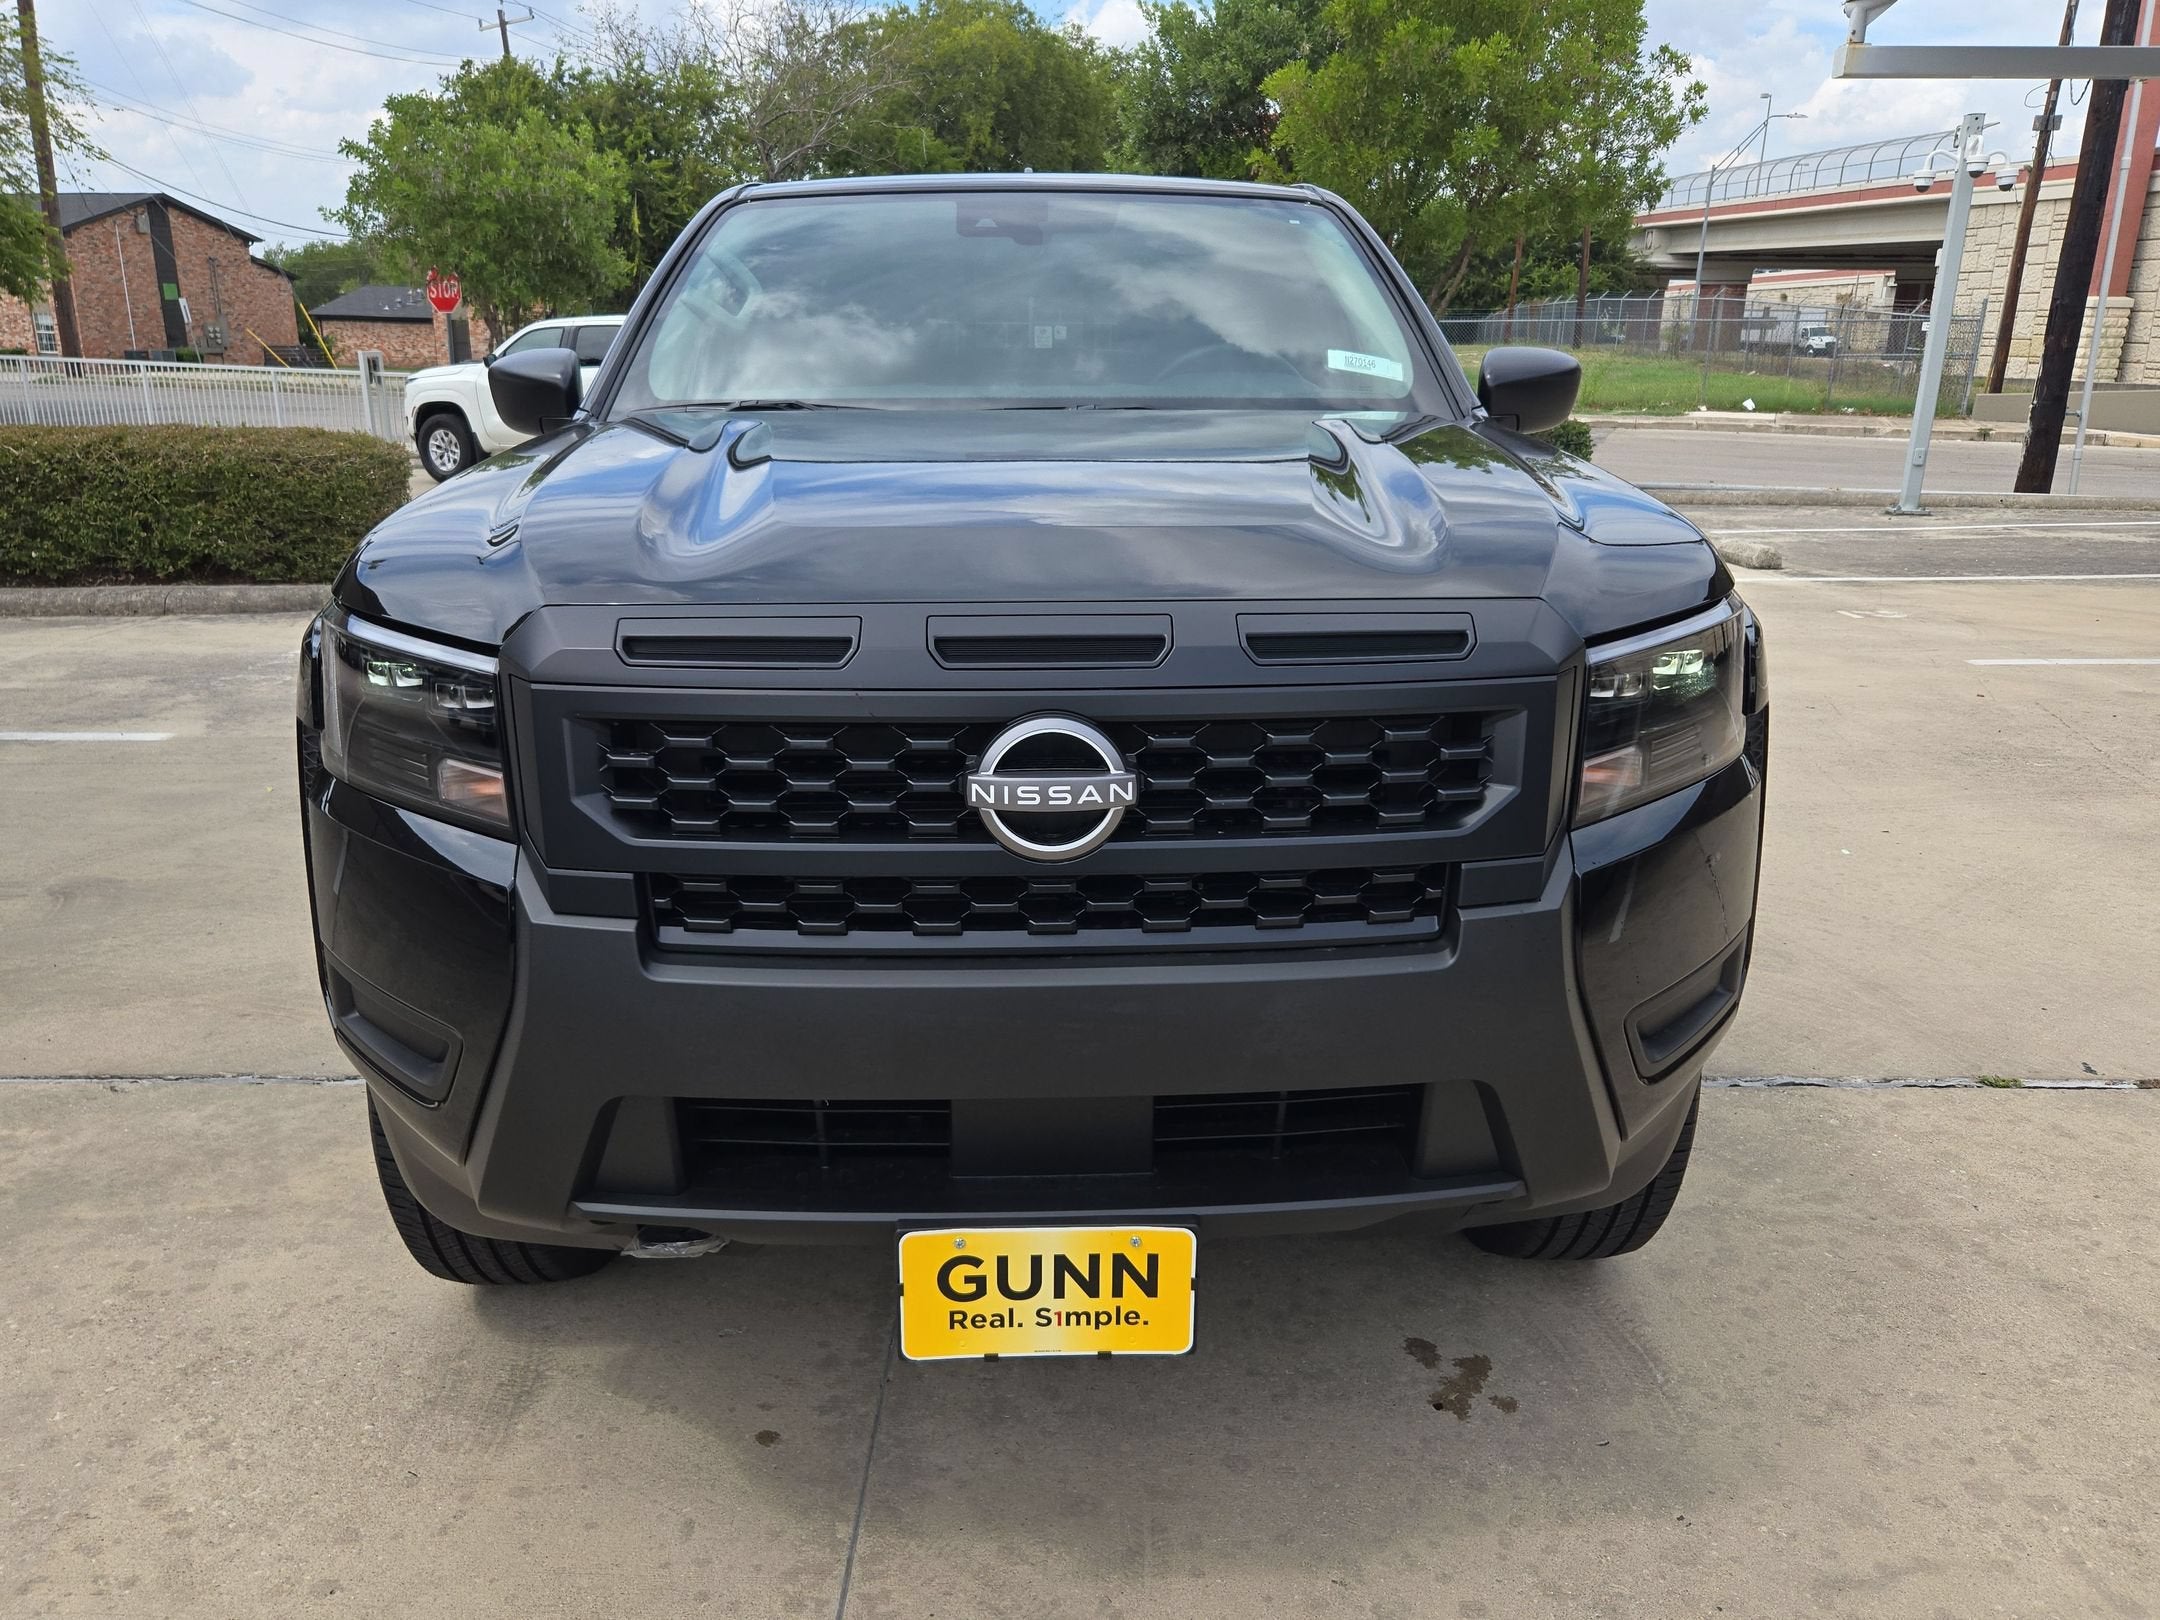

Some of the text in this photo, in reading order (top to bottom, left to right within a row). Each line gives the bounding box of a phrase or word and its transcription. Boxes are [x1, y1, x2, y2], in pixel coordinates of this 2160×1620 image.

[430, 281, 459, 299] STOP
[971, 781, 1133, 805] NISSAN
[936, 1252, 1159, 1302] GUNN
[949, 1308, 1023, 1330] Real.
